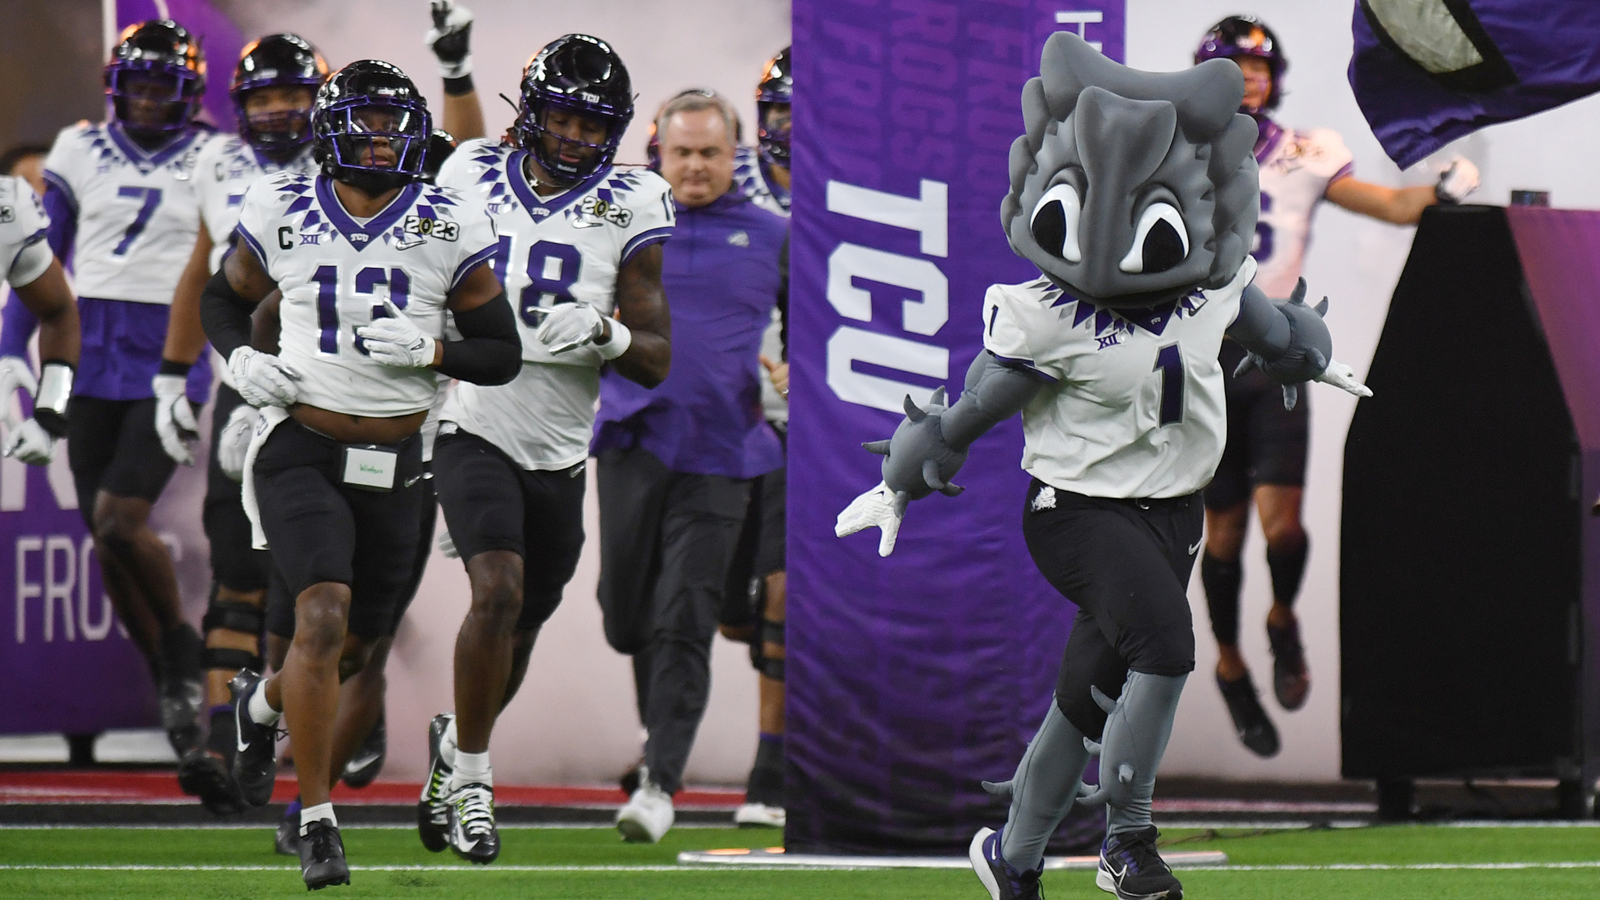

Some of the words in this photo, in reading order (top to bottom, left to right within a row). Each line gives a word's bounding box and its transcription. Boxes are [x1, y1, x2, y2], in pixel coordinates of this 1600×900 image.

[582, 91, 600, 104] TCU
[112, 185, 164, 256] 7
[404, 215, 460, 242] 2023
[278, 226, 294, 250] C
[350, 233, 370, 243] TCU
[826, 179, 950, 415] TCU
[1152, 341, 1186, 430] 1
